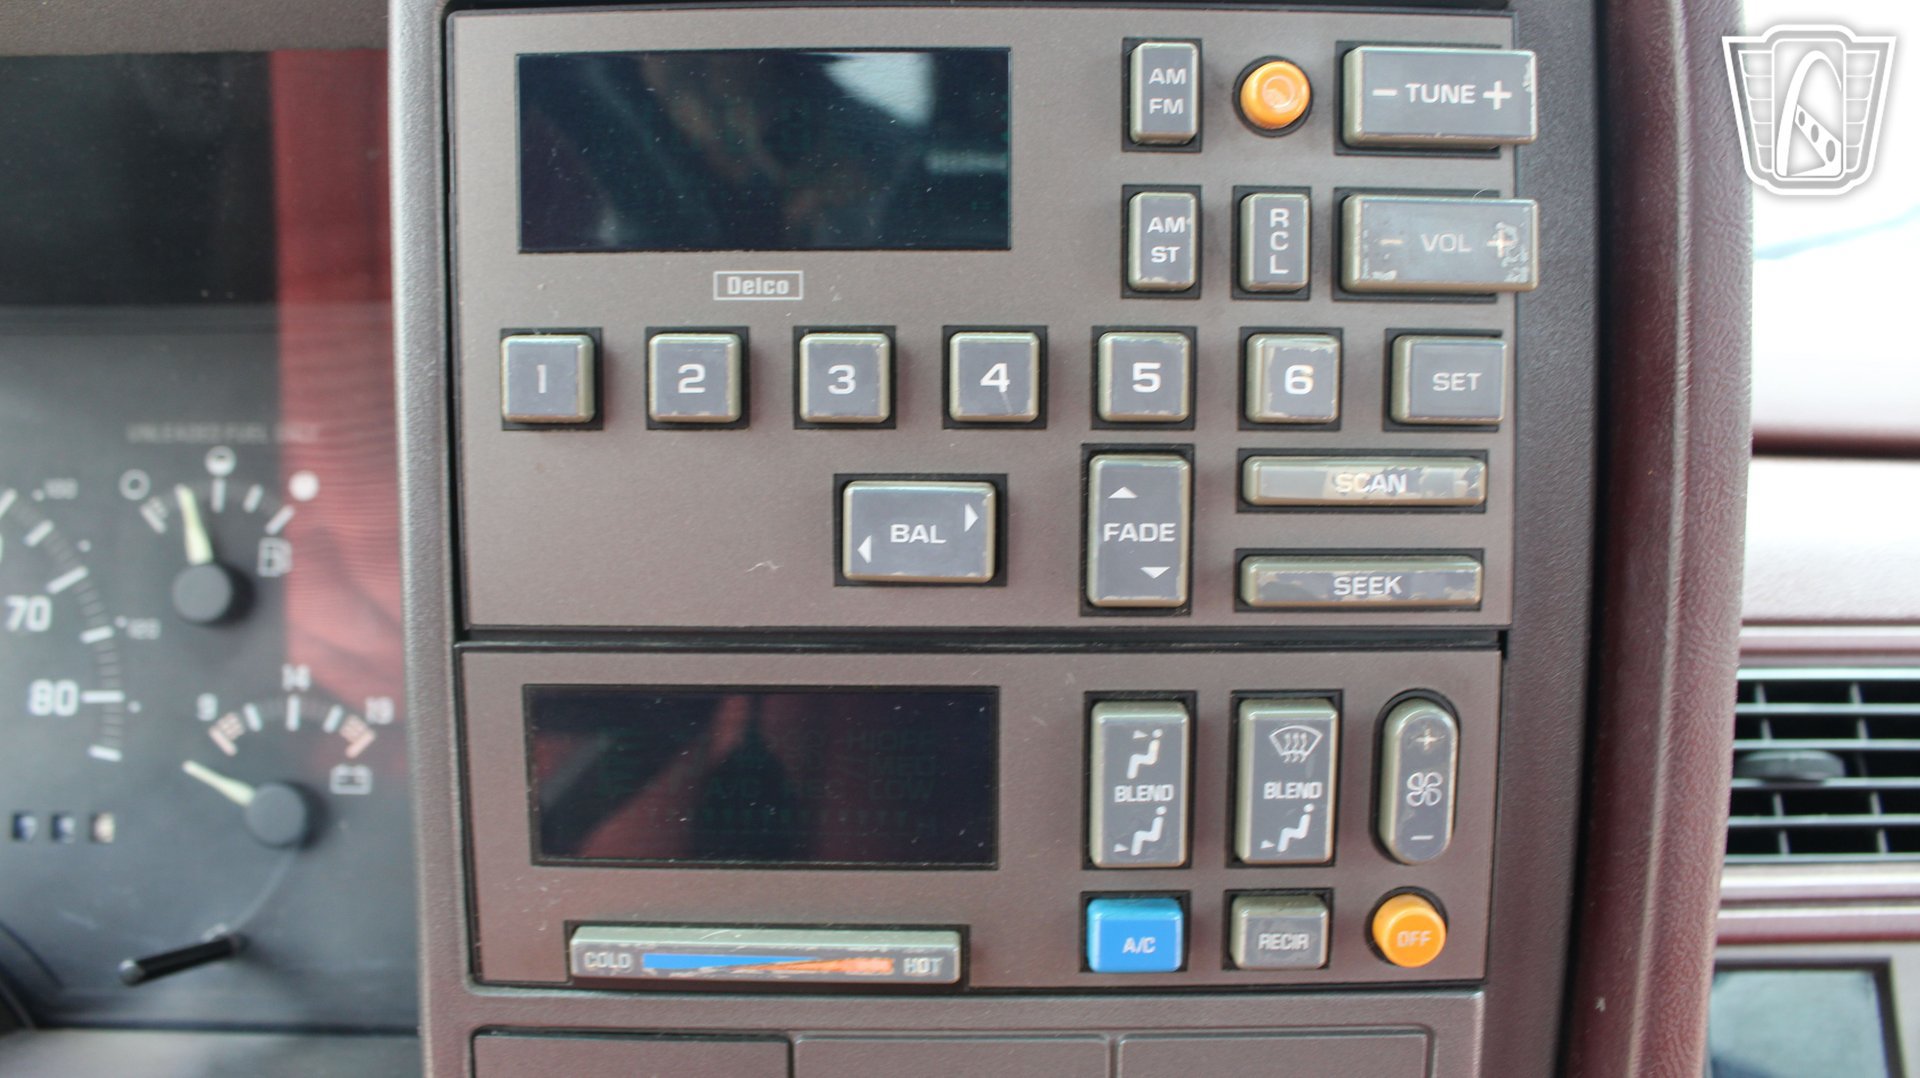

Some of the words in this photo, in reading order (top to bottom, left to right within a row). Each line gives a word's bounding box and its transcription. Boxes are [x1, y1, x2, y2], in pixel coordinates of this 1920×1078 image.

[1149, 68, 1186, 84] AM
[1405, 83, 1475, 105] TUNE
[1149, 99, 1183, 115] FM
[1148, 217, 1186, 233] AM
[1421, 233, 1471, 253] VOL
[1151, 246, 1180, 262] ST
[727, 275, 789, 296] Delco
[536, 365, 547, 394] 1
[677, 364, 706, 394] 2
[828, 365, 856, 395] 3
[980, 363, 1010, 393] 4
[1132, 362, 1161, 393] 5
[1284, 366, 1314, 395] 6
[1432, 372, 1482, 391] SET
[1334, 474, 1407, 493] SCAN
[890, 524, 946, 545] BAL
[1103, 522, 1175, 543] FADE
[1334, 576, 1402, 596] SEEK
[5, 596, 52, 632] 70
[29, 680, 79, 716] 80
[1115, 784, 1174, 802] BLEND
[1264, 781, 1322, 799] BLEND
[1122, 936, 1155, 954] A/C
[1259, 932, 1309, 951] RECIR
[1397, 930, 1432, 948] OFF
[584, 951, 631, 972] COLD
[902, 957, 943, 976] HOT
